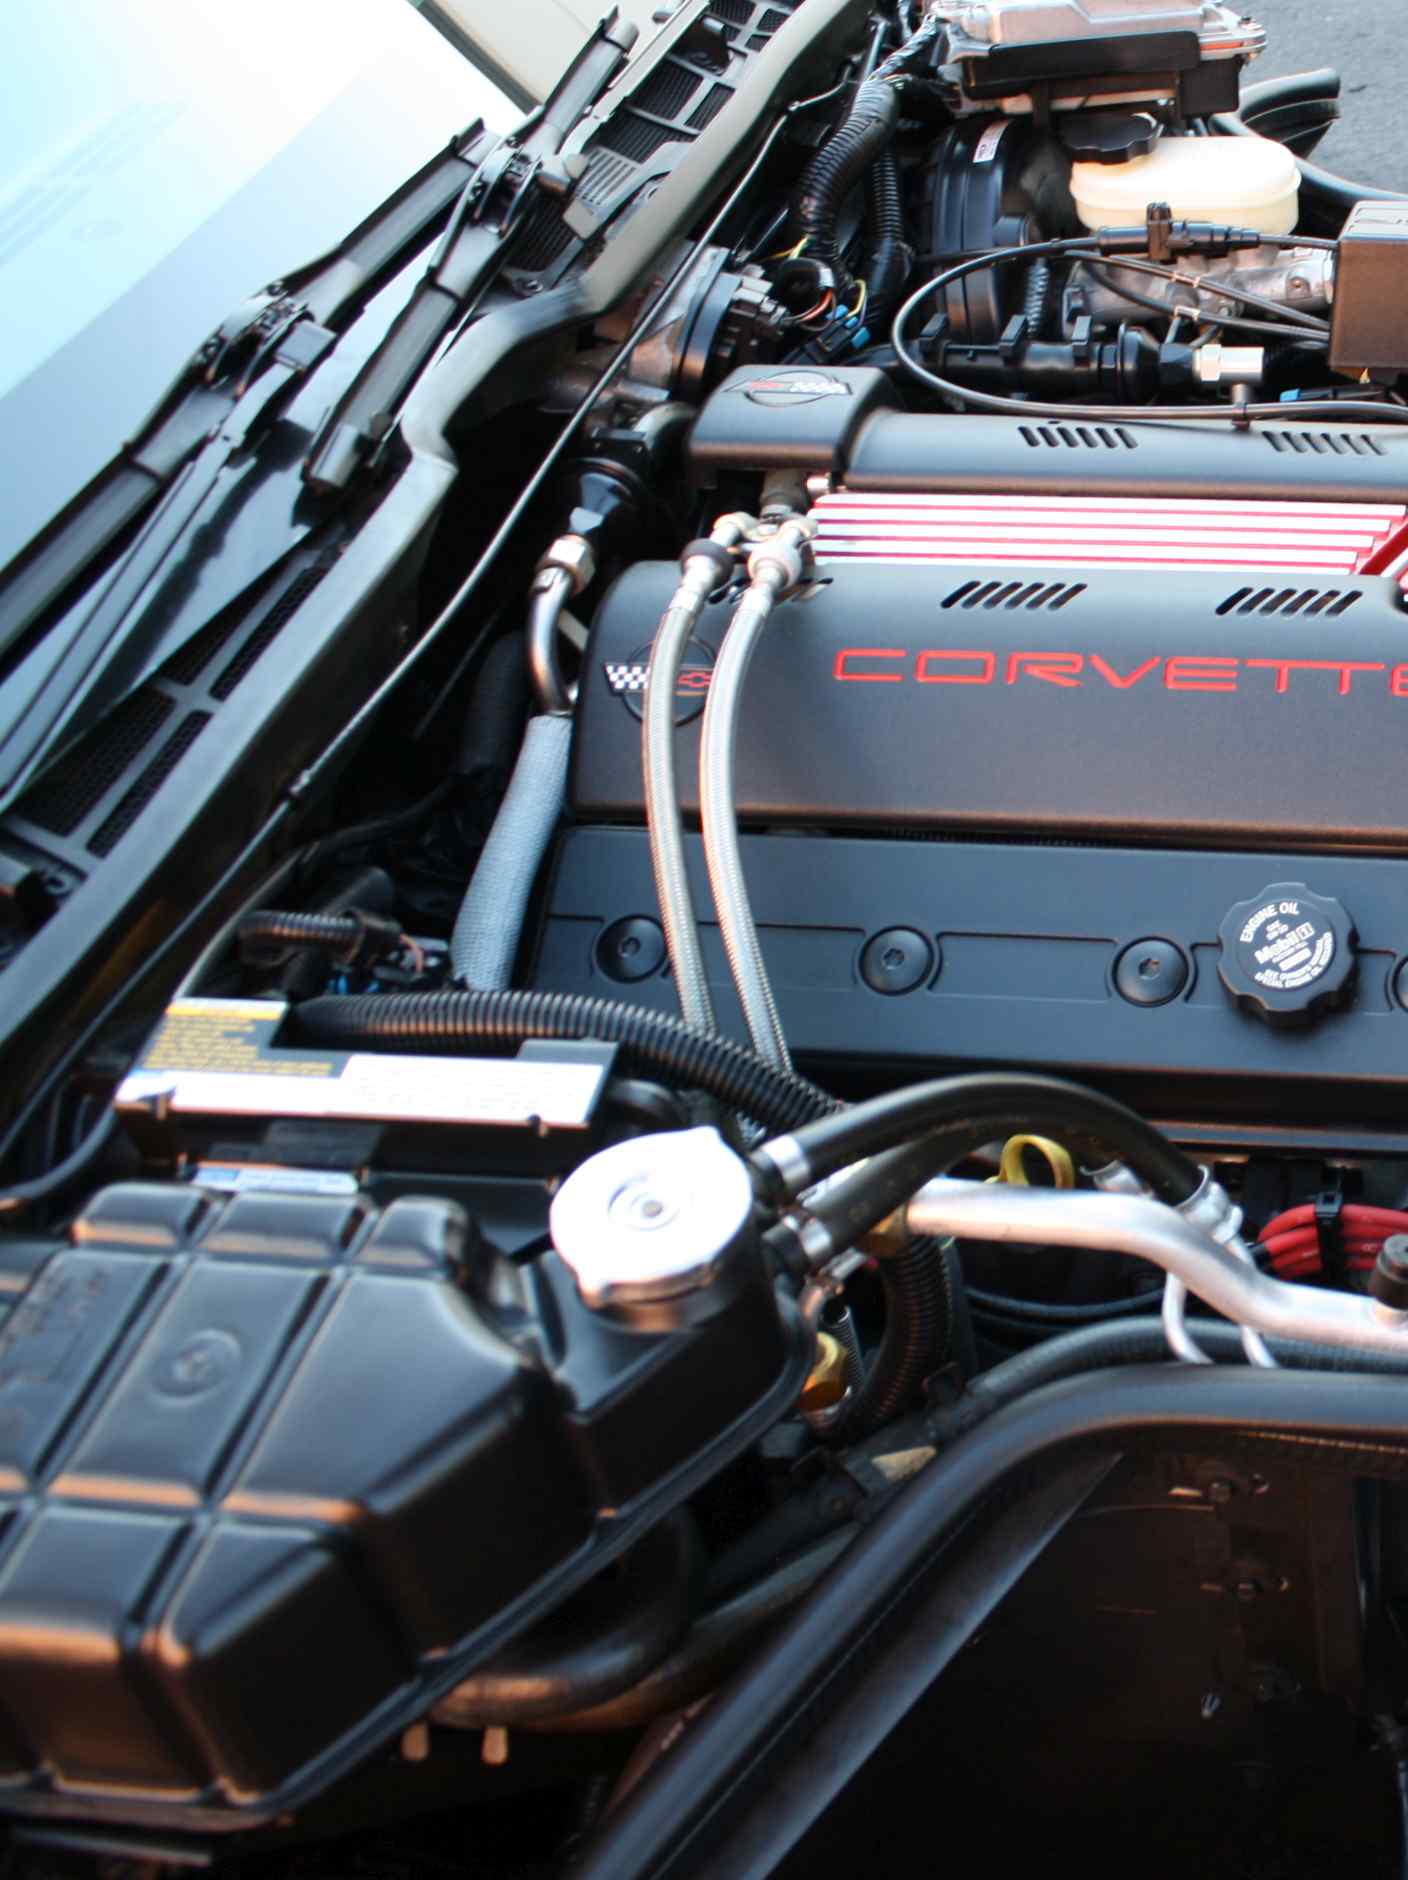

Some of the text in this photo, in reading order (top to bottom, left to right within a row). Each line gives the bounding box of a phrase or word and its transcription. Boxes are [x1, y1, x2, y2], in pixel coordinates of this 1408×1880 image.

[1240, 904, 1279, 943] ENGINE
[1279, 902, 1300, 916] OIL
[1254, 930, 1300, 965] Mobil
